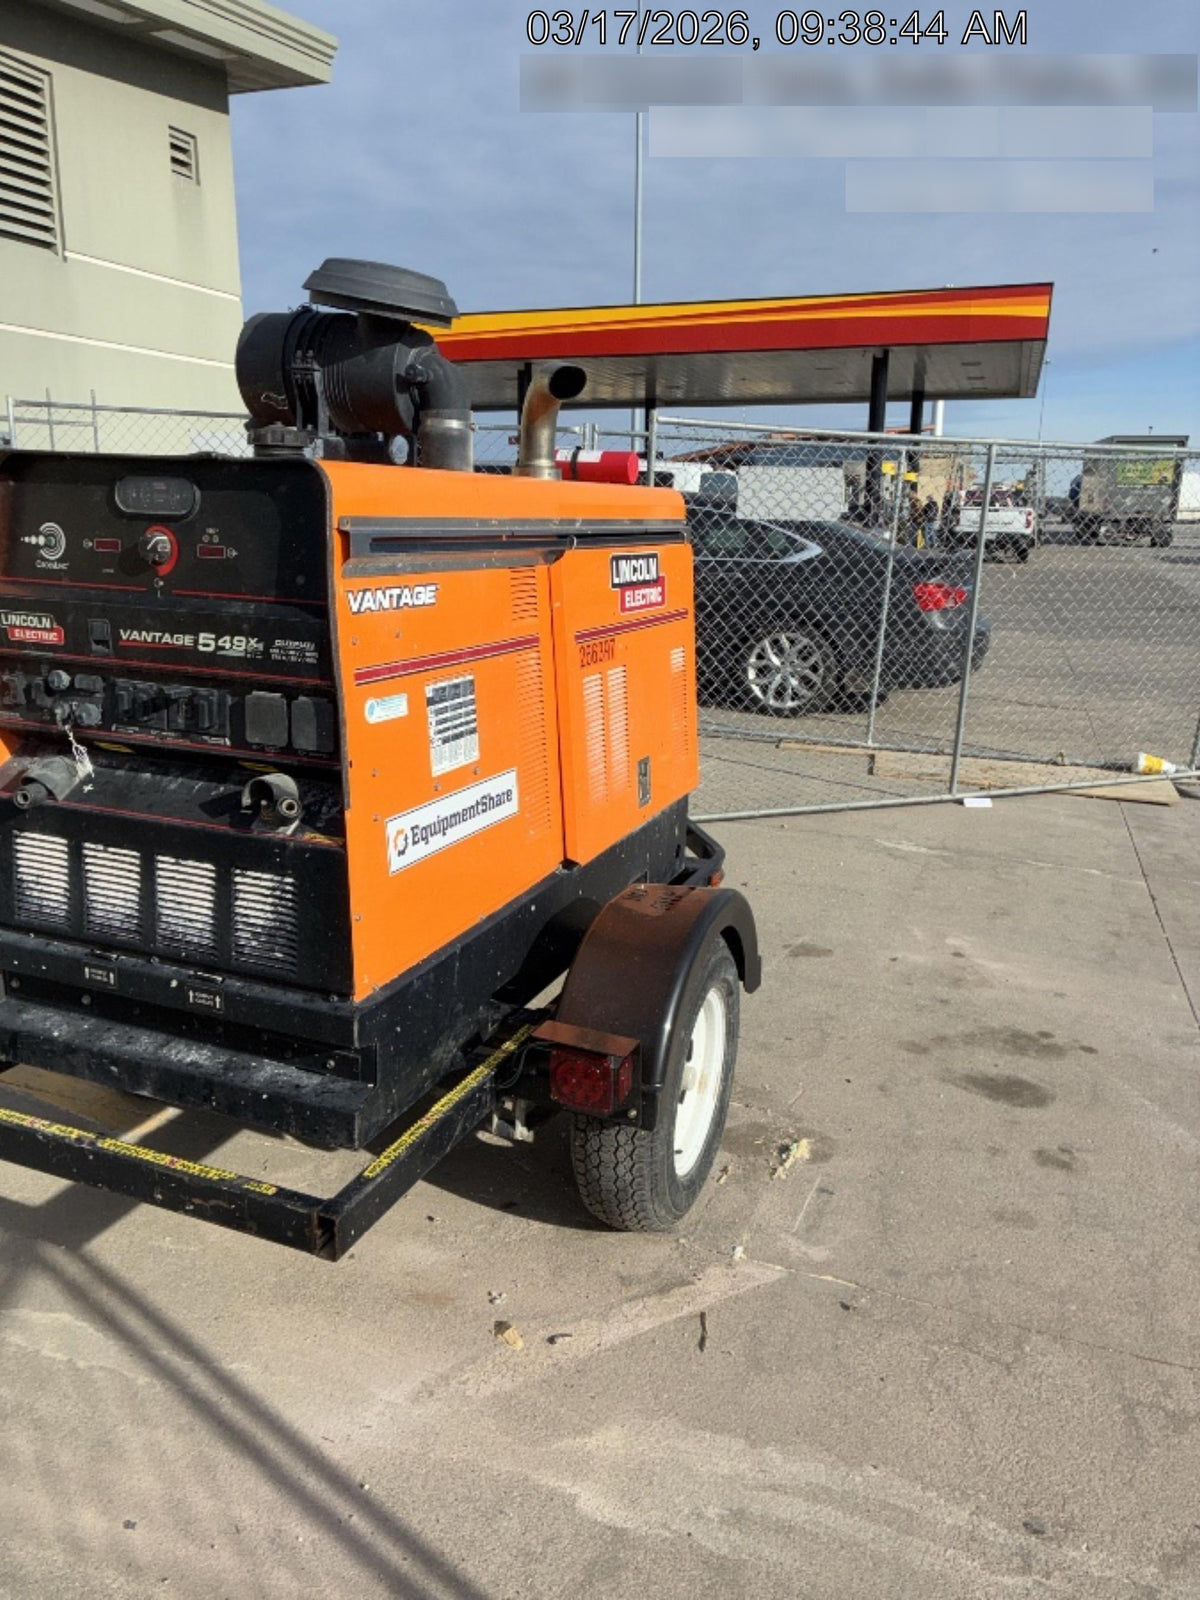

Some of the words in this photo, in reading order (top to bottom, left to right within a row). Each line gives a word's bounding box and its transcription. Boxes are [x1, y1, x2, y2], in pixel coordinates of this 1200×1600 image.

[612, 557, 657, 583] LINCOLN
[346, 584, 439, 613] VANTAGE
[624, 586, 663, 608] ELECTRIC
[1, 613, 52, 628] LINCOLN
[14, 629, 59, 641] ELECTRIC
[118, 628, 194, 647] VANTAGE
[410, 788, 513, 847] EquipmentShare
